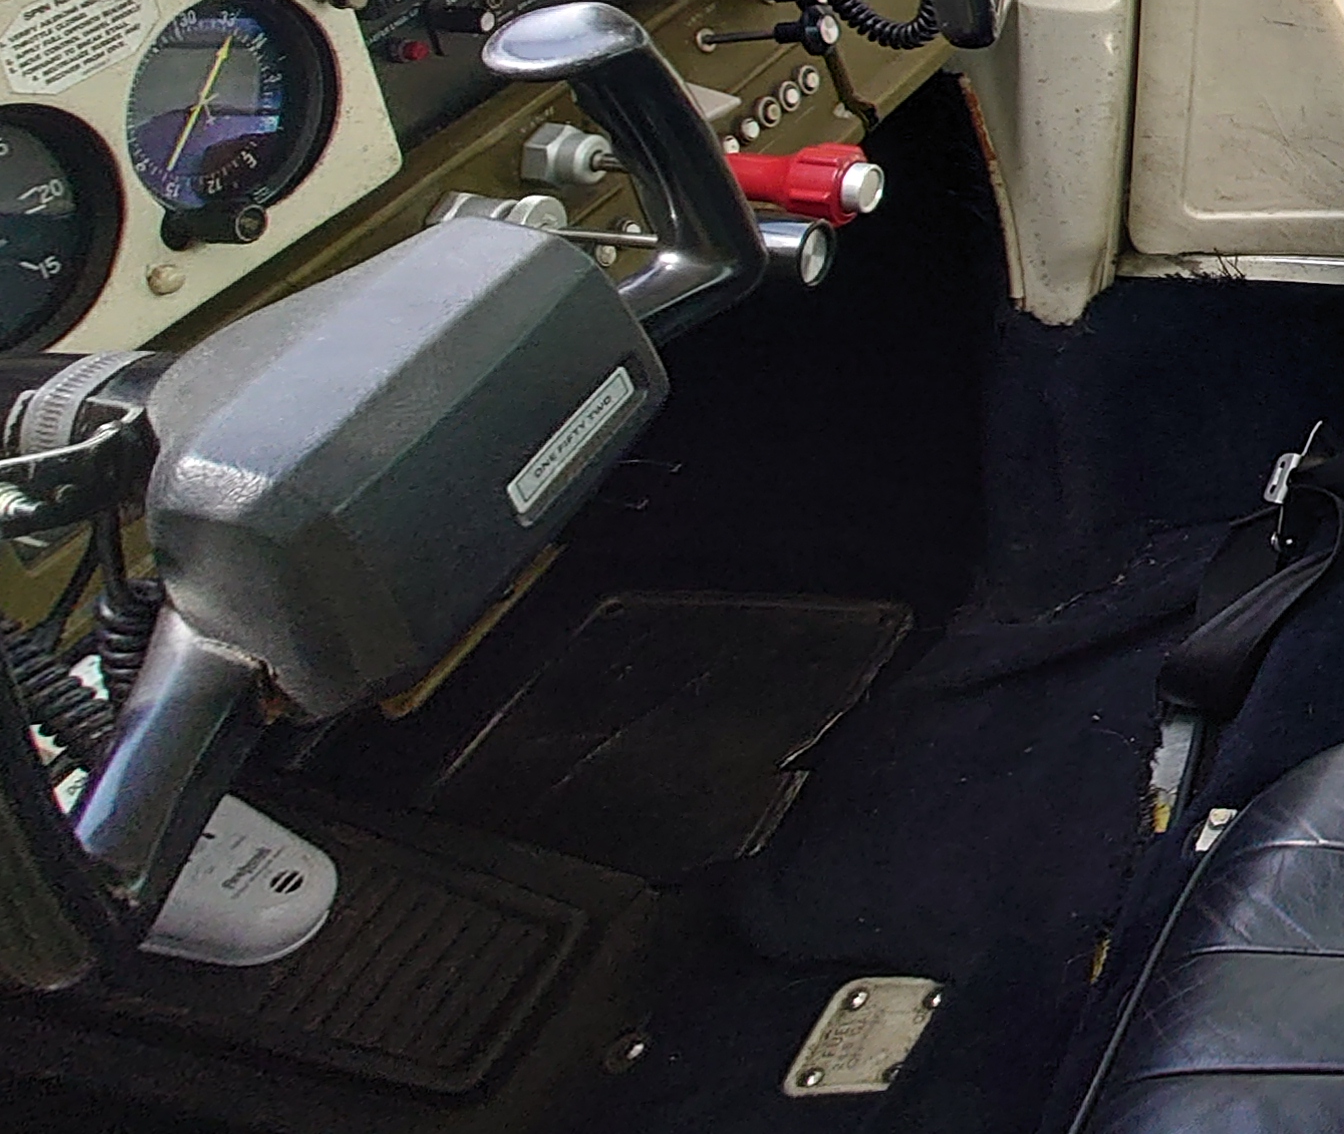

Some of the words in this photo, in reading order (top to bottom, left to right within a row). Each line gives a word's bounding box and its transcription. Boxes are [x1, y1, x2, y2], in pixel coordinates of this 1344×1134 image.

[534, 452, 557, 479] ONE
[557, 420, 587, 454] FIFTY
[587, 394, 613, 421] TWO
